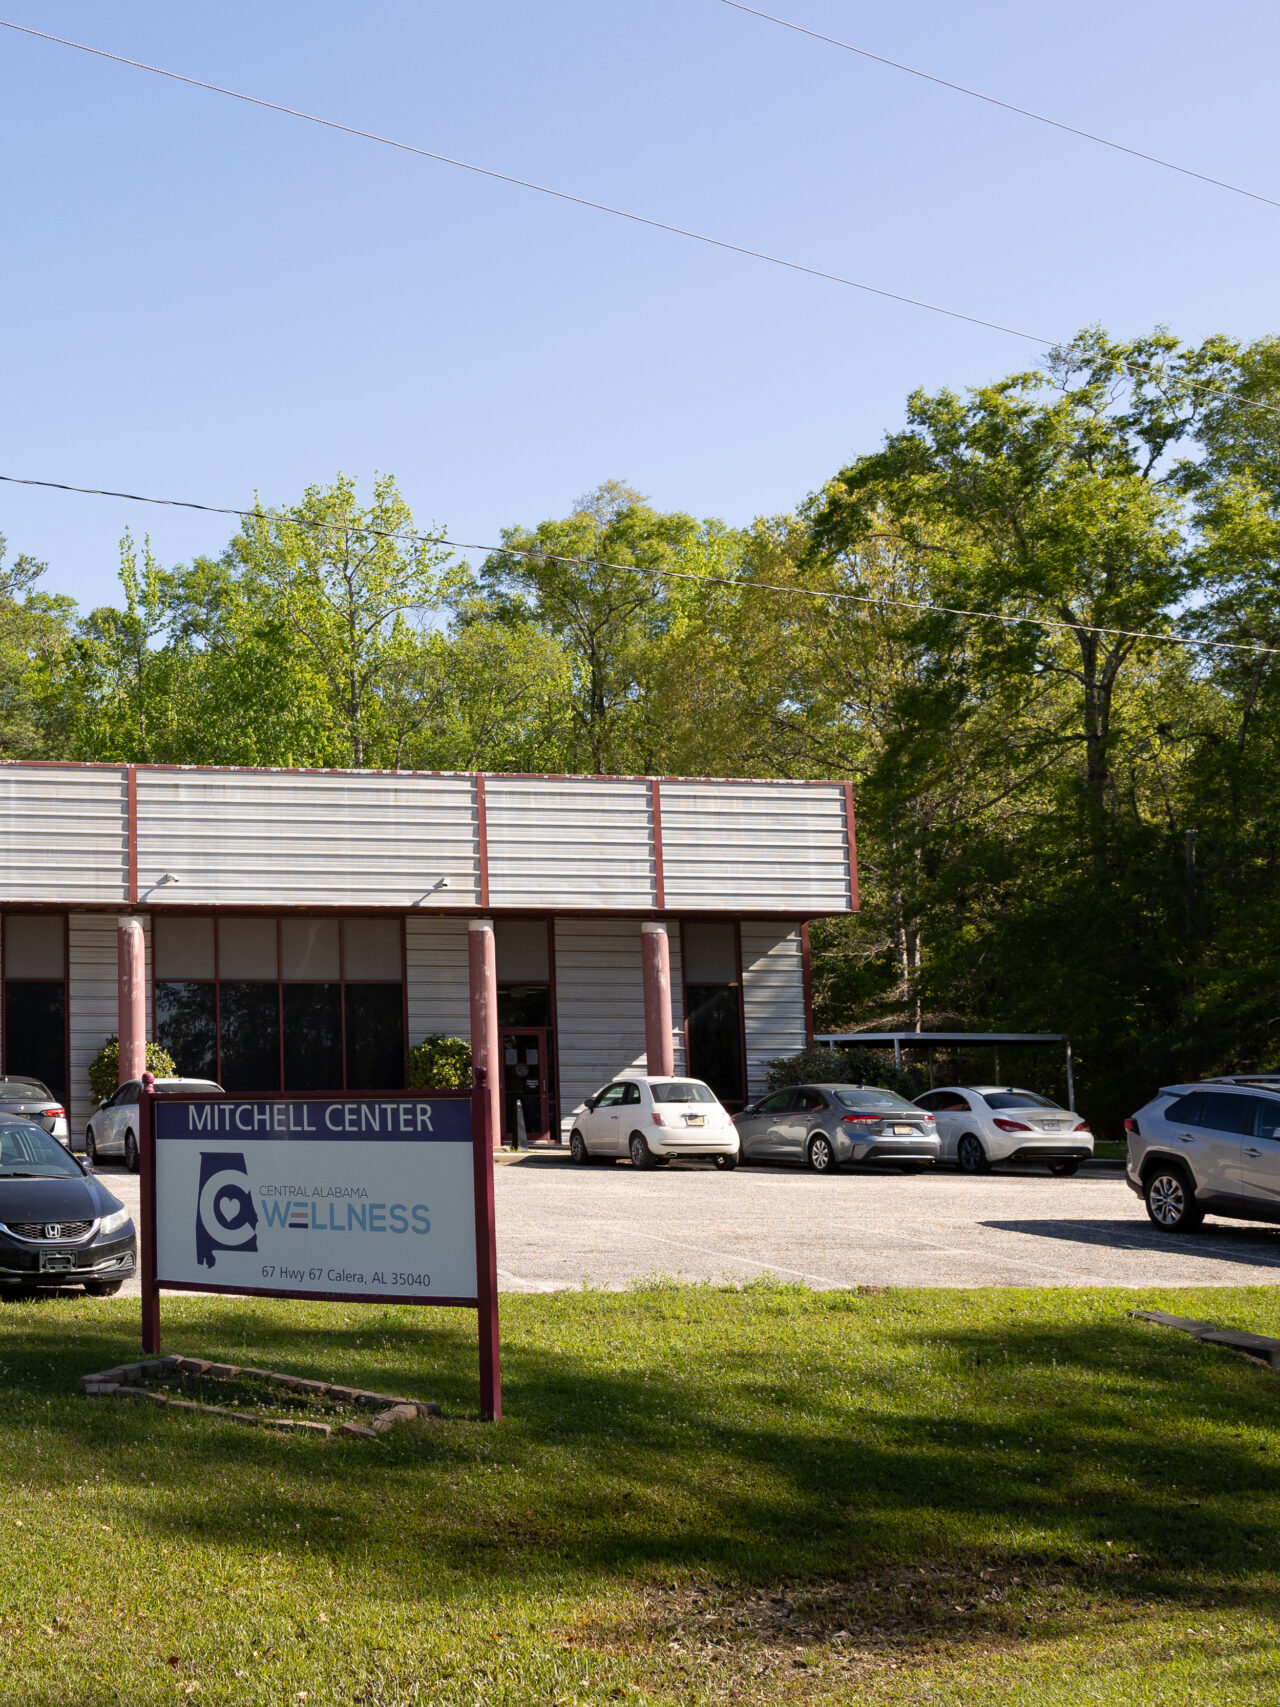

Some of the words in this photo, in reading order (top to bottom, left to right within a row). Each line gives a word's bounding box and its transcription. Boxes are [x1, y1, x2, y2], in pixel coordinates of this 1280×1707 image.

[188, 1104, 317, 1131] MITCHELL
[324, 1103, 434, 1132] CENTER
[258, 1184, 311, 1198] CENTRAL
[311, 1186, 369, 1199] ALABAMA
[261, 1199, 432, 1235] WELLNESS
[261, 1265, 276, 1278] 67
[279, 1266, 306, 1283] Hwy
[308, 1268, 323, 1281] 67
[327, 1269, 368, 1286] Calera,
[371, 1271, 387, 1285] AL
[391, 1272, 431, 1287] 35040
